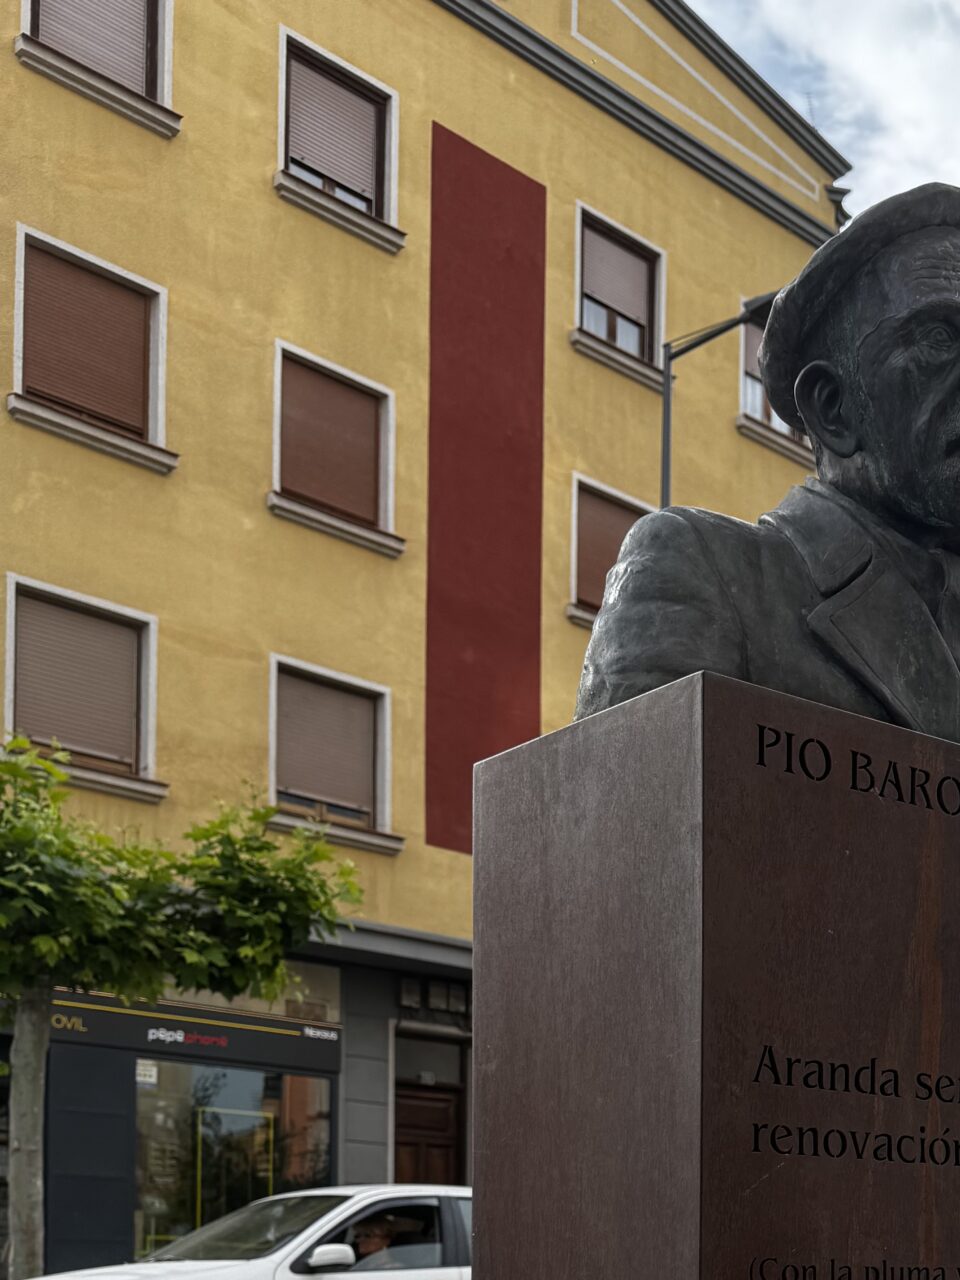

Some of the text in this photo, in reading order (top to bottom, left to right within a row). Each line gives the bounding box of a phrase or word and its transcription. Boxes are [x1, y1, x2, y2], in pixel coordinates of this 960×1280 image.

[756, 724, 832, 782] PIO
[50, 1013, 88, 1032] OVIL
[752, 1044, 901, 1098] Aranda
